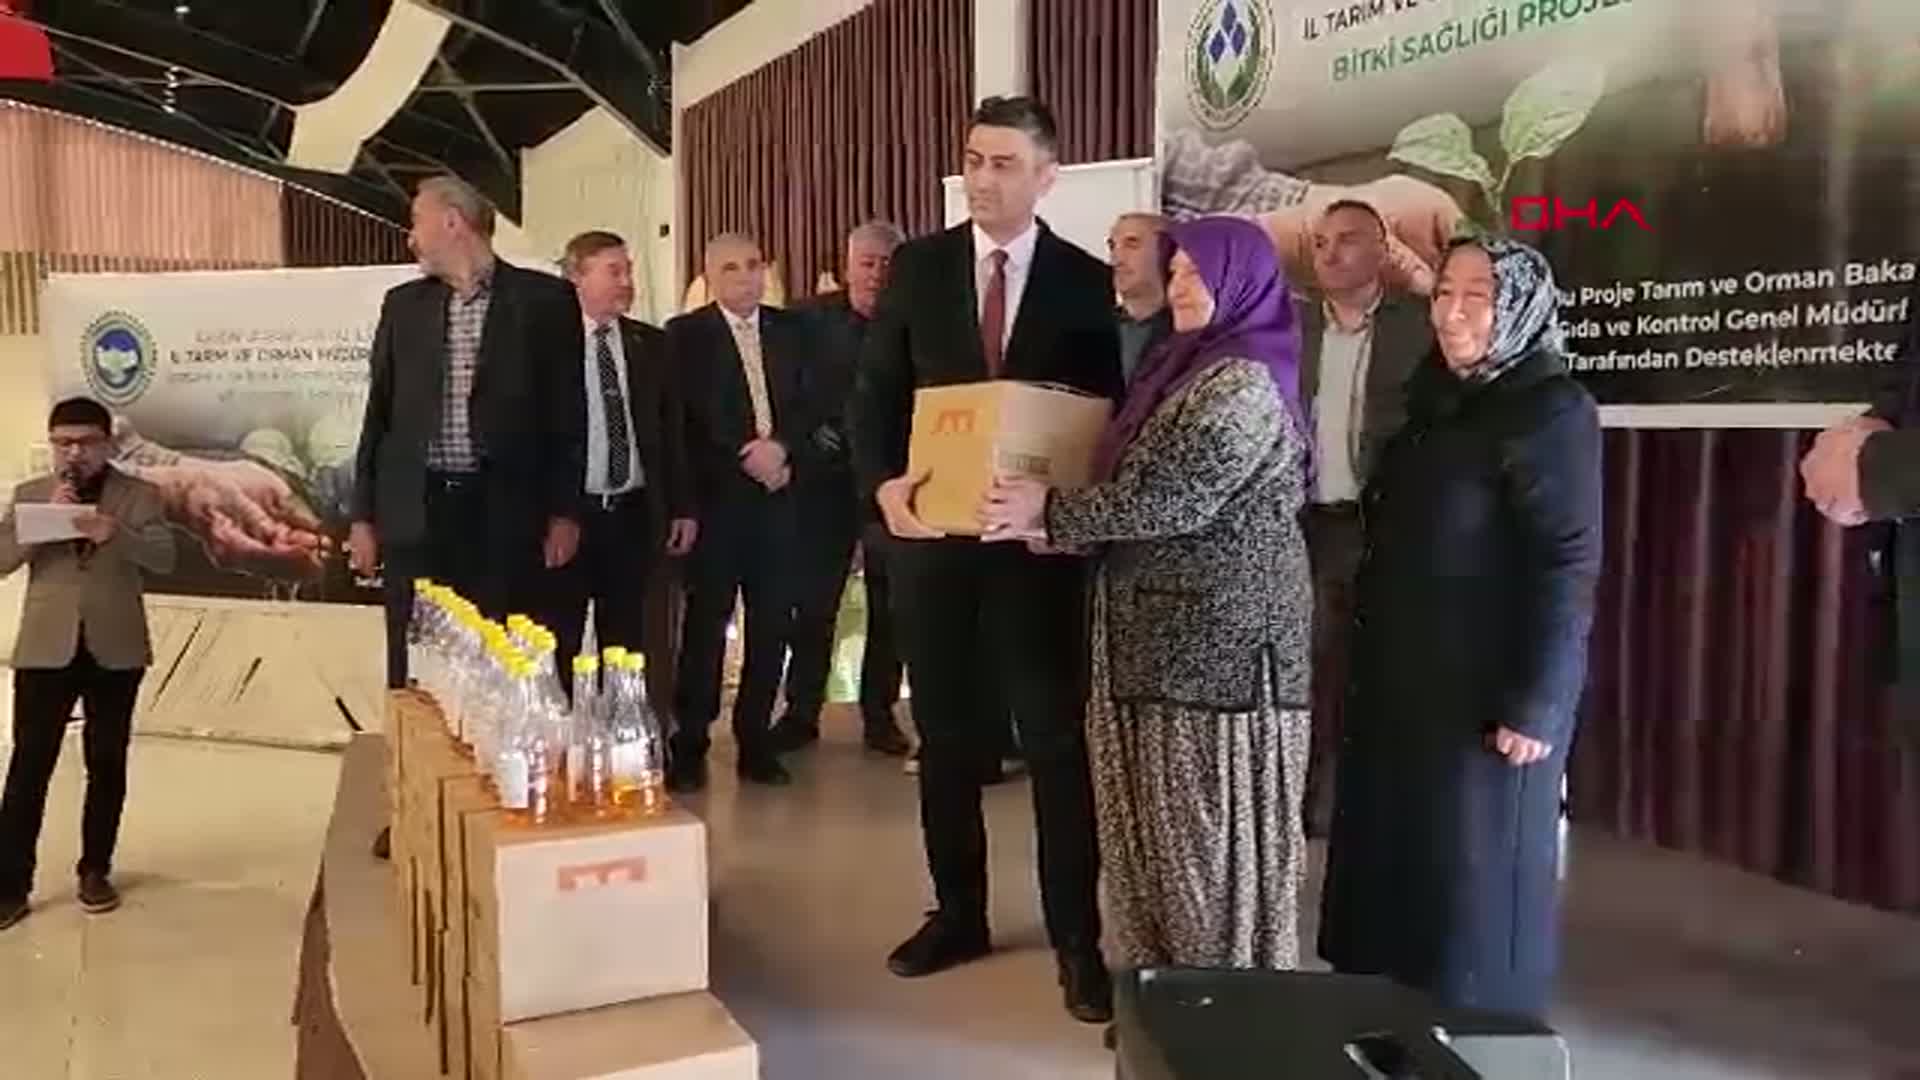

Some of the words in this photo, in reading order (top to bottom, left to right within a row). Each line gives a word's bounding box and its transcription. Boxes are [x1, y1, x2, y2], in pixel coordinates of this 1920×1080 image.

[1332, 37, 1395, 81] BİTKİ
[1401, 6, 1508, 64] SAĞLIĞI
[1517, 0, 1621, 31] PROJ
[1581, 281, 1635, 308] Proje
[1710, 277, 1738, 294] ve
[1744, 269, 1834, 293] Orman
[1844, 258, 1916, 286] Baka
[1605, 320, 1631, 336] ve
[1637, 308, 1720, 335] Kontrol
[1726, 304, 1798, 331] Genel
[1566, 349, 1679, 371] Tarafından
[1685, 339, 1898, 368] Desteklenmekte
